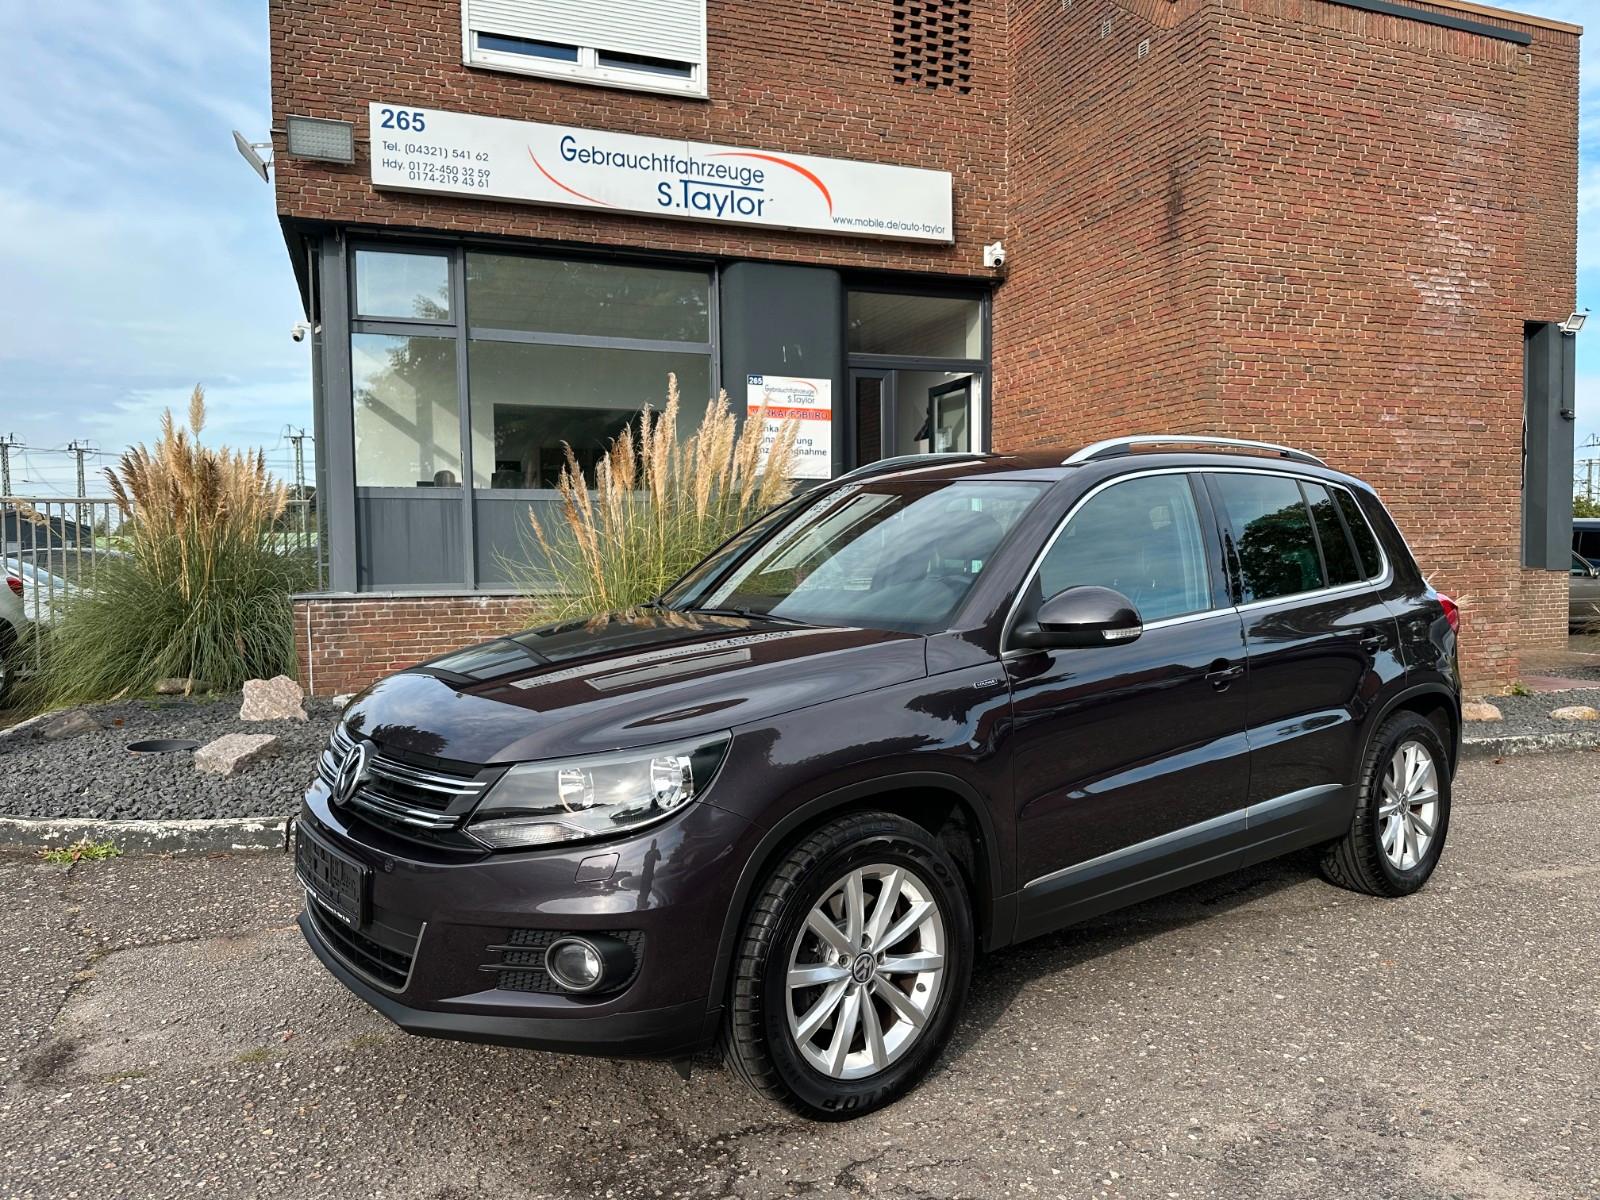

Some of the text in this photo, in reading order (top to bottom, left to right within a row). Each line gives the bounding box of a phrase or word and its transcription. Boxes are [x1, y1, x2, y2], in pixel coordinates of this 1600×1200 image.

[381, 109, 426, 133] 265
[382, 140, 489, 162] Tel. (04321) 541 62
[560, 135, 765, 186] Gebrauchtfahrzeuge
[382, 158, 491, 179] Hdy. 0172-450 32 59
[408, 171, 490, 188] 0174-219 43 61
[657, 179, 765, 217] S.Taylor
[832, 215, 945, 235] www.mobile.de/auto-taylor
[748, 377, 763, 385] 265
